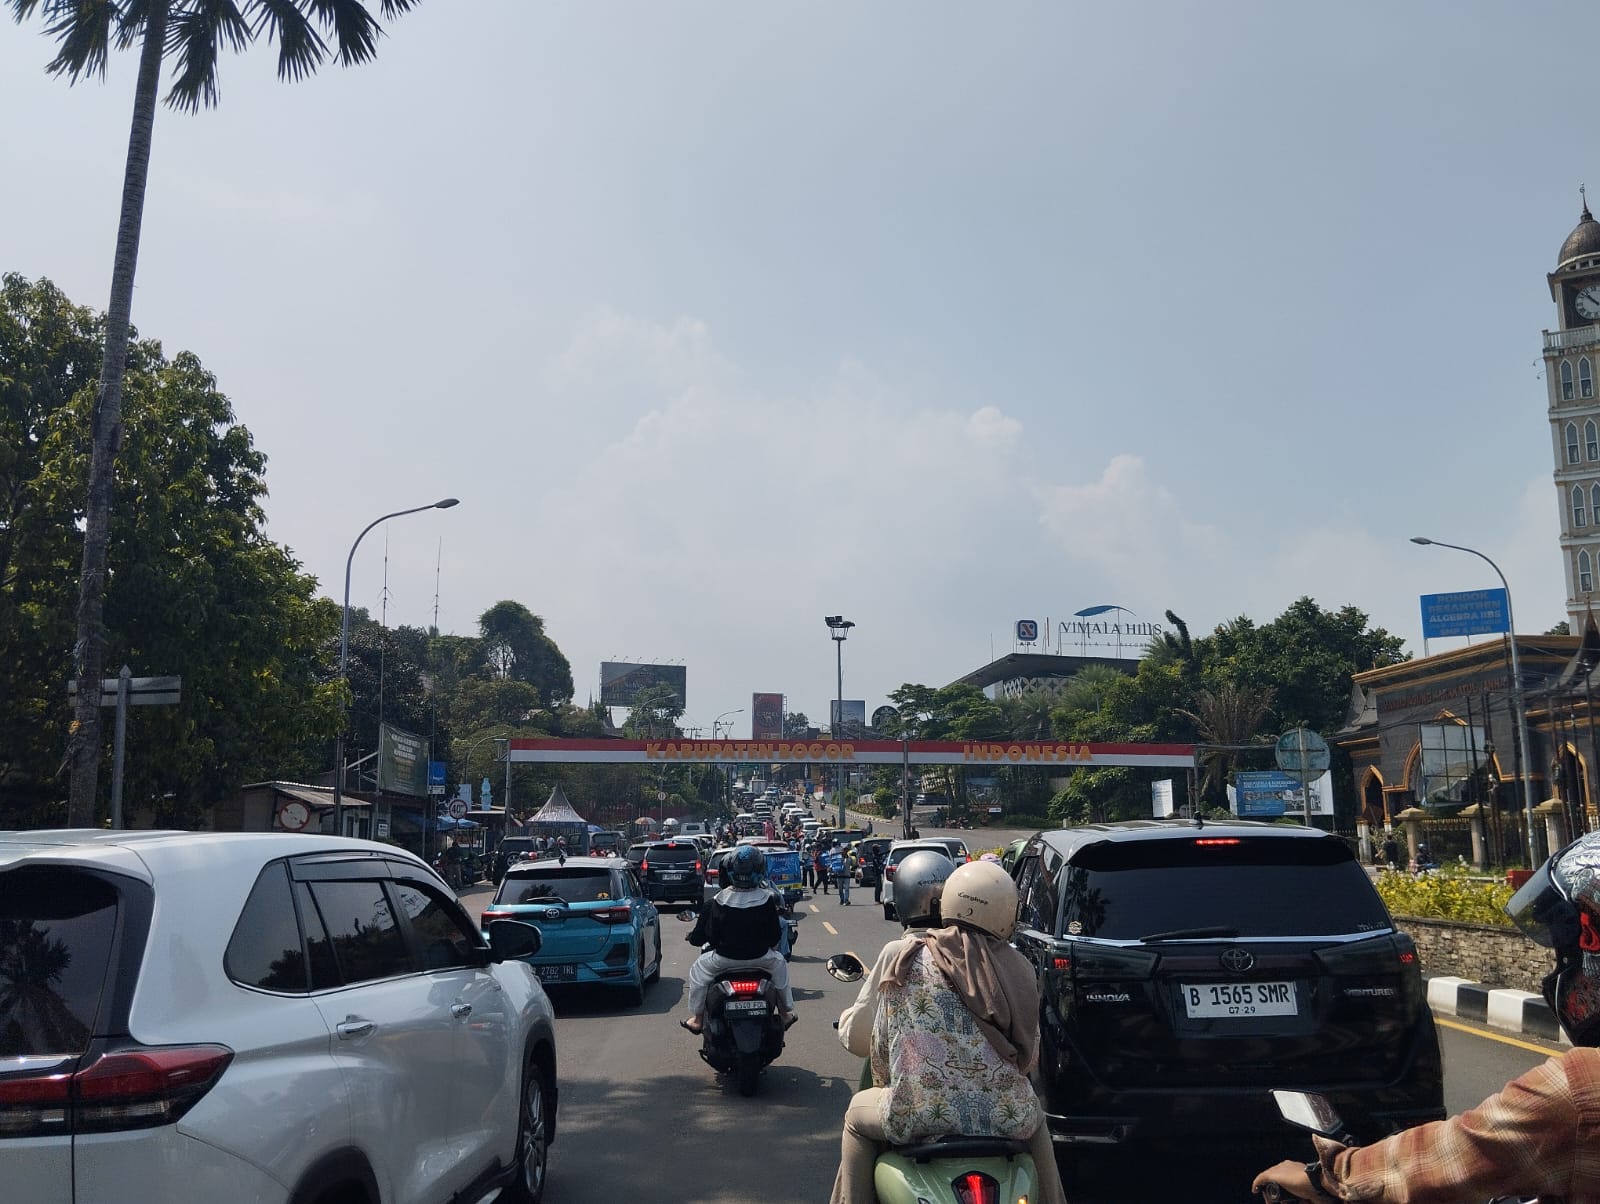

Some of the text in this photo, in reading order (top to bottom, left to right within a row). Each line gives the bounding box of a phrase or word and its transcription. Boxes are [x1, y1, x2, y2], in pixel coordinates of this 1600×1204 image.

[1437, 592, 1489, 603] PONDOK
[1428, 601, 1500, 613] PESANTREN
[1429, 612, 1478, 623] ALGEBRA
[646, 743, 855, 760] KABUPATEN BOGOR
[964, 744, 1093, 762] INDONESIA
[1086, 993, 1131, 1002] INNOVA
[1189, 983, 1290, 1006] B 1565 SMR
